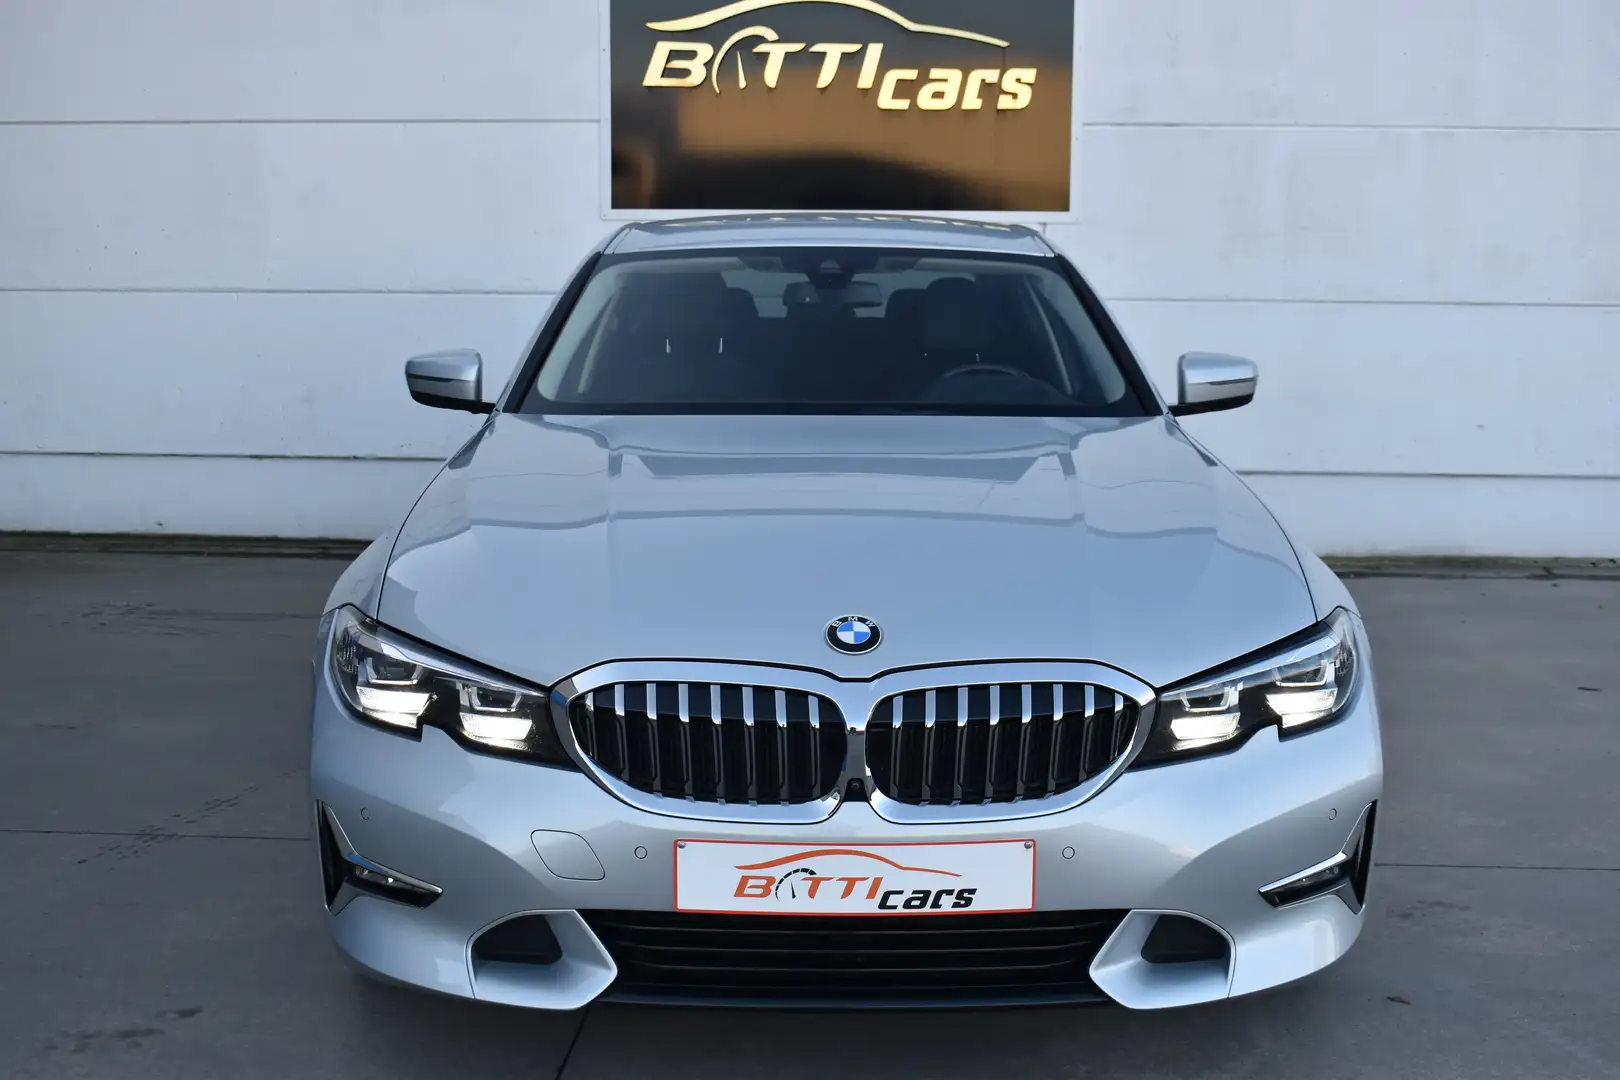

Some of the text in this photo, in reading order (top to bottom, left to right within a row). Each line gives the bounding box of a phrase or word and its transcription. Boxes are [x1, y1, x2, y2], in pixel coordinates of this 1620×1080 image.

[876, 68, 1037, 111] cars
[831, 616, 876, 627] BMW
[877, 887, 978, 910] cars
